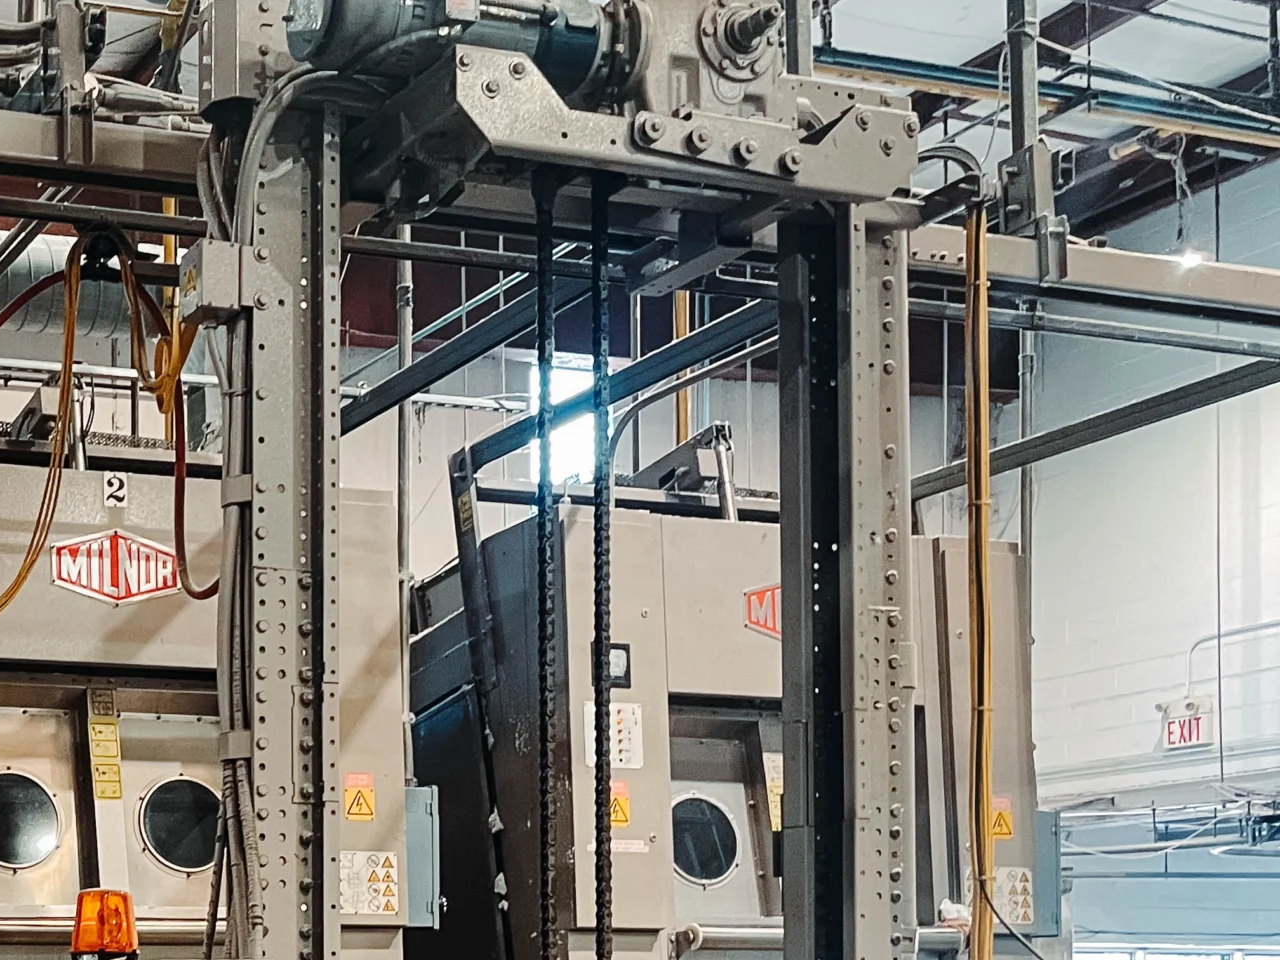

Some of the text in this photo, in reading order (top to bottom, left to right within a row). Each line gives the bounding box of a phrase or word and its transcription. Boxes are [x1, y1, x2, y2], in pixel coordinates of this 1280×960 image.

[106, 476, 126, 503] 2
[60, 537, 174, 599] MILNOR
[1167, 716, 1202, 745] EXIT
